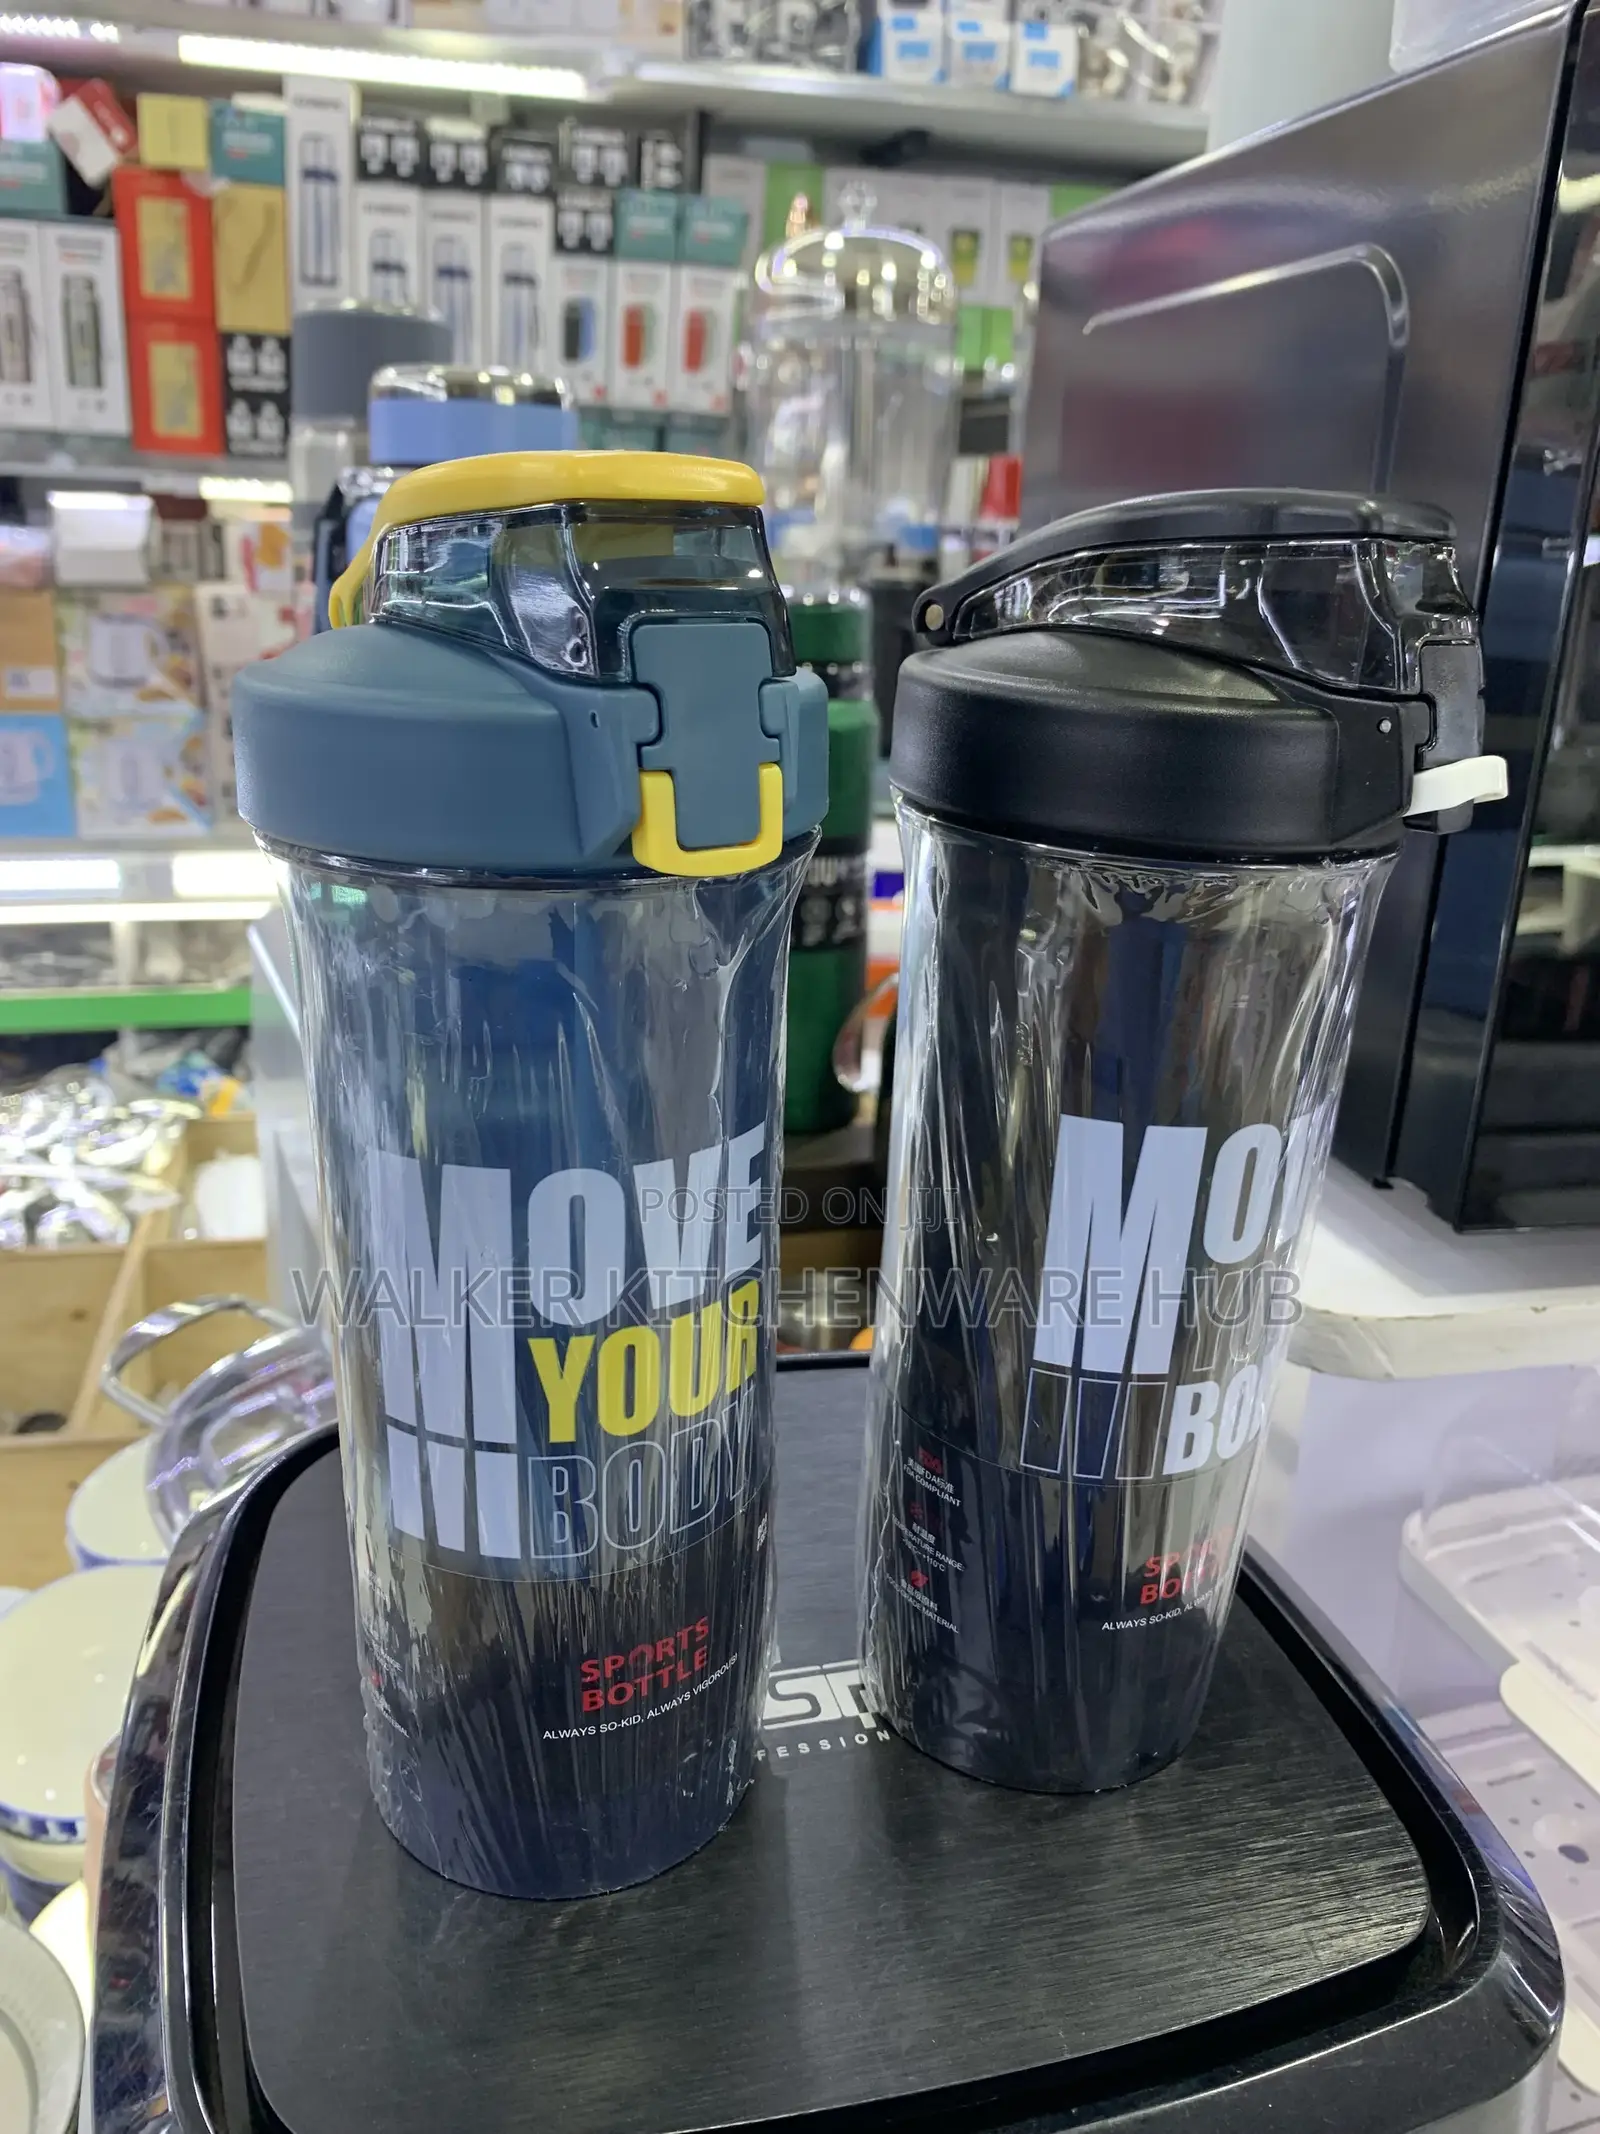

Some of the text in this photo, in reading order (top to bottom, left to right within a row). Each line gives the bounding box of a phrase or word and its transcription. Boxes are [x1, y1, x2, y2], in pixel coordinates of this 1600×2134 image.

[366, 1120, 765, 1450] MOVE
[528, 1279, 759, 1444] YOUR
[528, 1380, 755, 1560] BODY
[915, 1474, 962, 1508] COMPLIANT
[580, 1615, 709, 1683] SPORTS
[921, 1606, 960, 1634] MATERIAL
[1102, 1617, 1147, 1631] ALWAYS
[1149, 1608, 1182, 1625] SO-KID,
[582, 1645, 708, 1712] BOTTLE
[543, 1725, 597, 1740] ALWAYS
[599, 1714, 645, 1734] SO-KID,
[647, 1691, 691, 1720] ALWAYS
